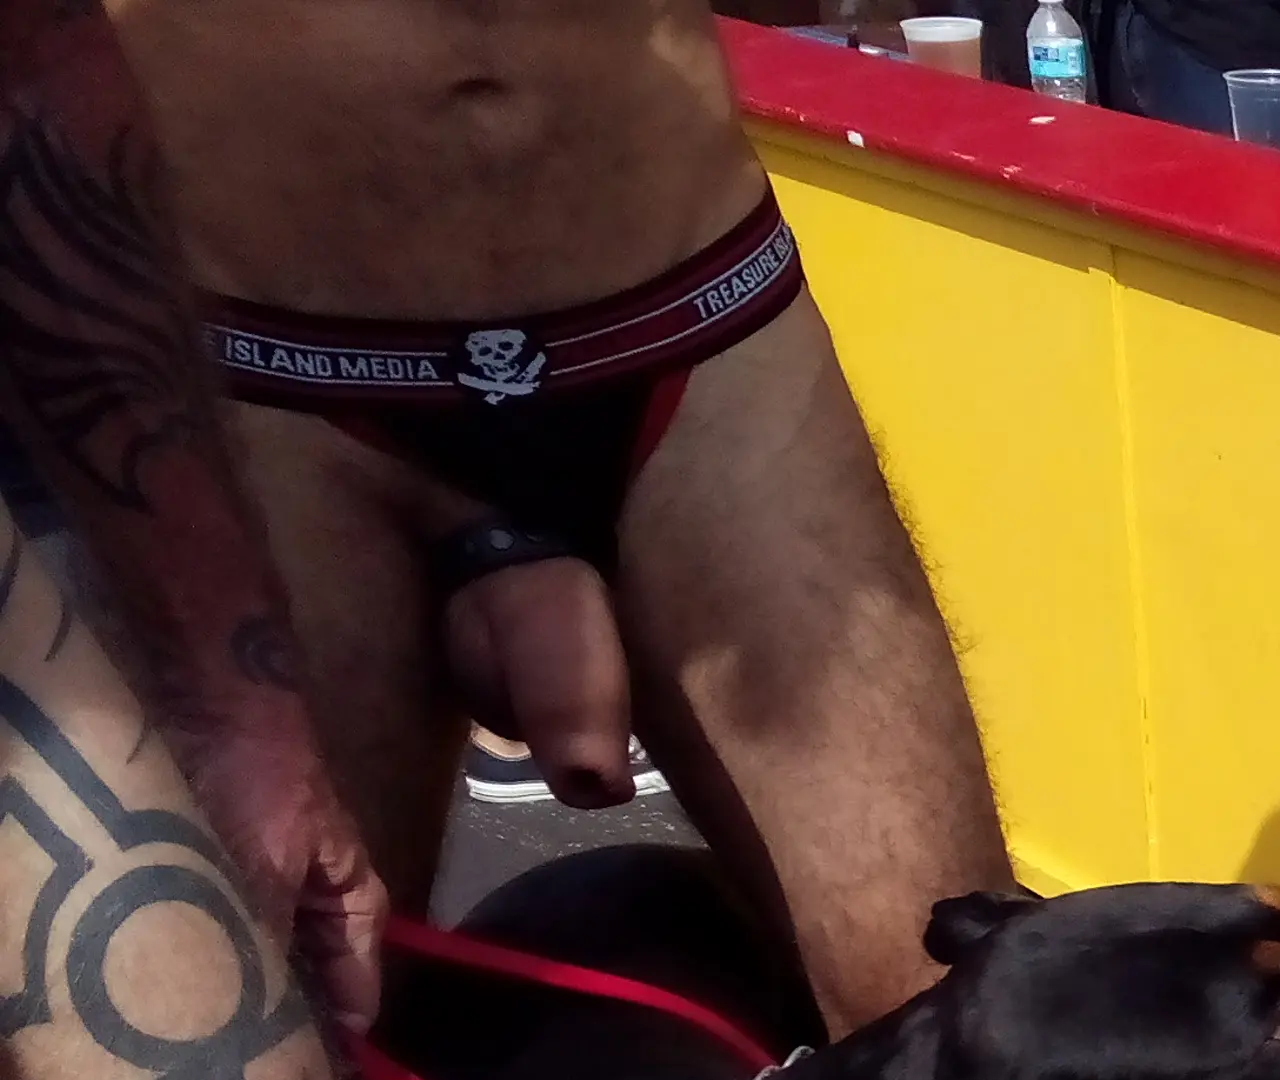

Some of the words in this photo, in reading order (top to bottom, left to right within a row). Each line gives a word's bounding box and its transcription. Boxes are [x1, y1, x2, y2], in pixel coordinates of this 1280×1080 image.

[693, 247, 780, 319] TREASURE
[225, 336, 331, 377] ISLAND
[339, 356, 439, 379] MEDIA
